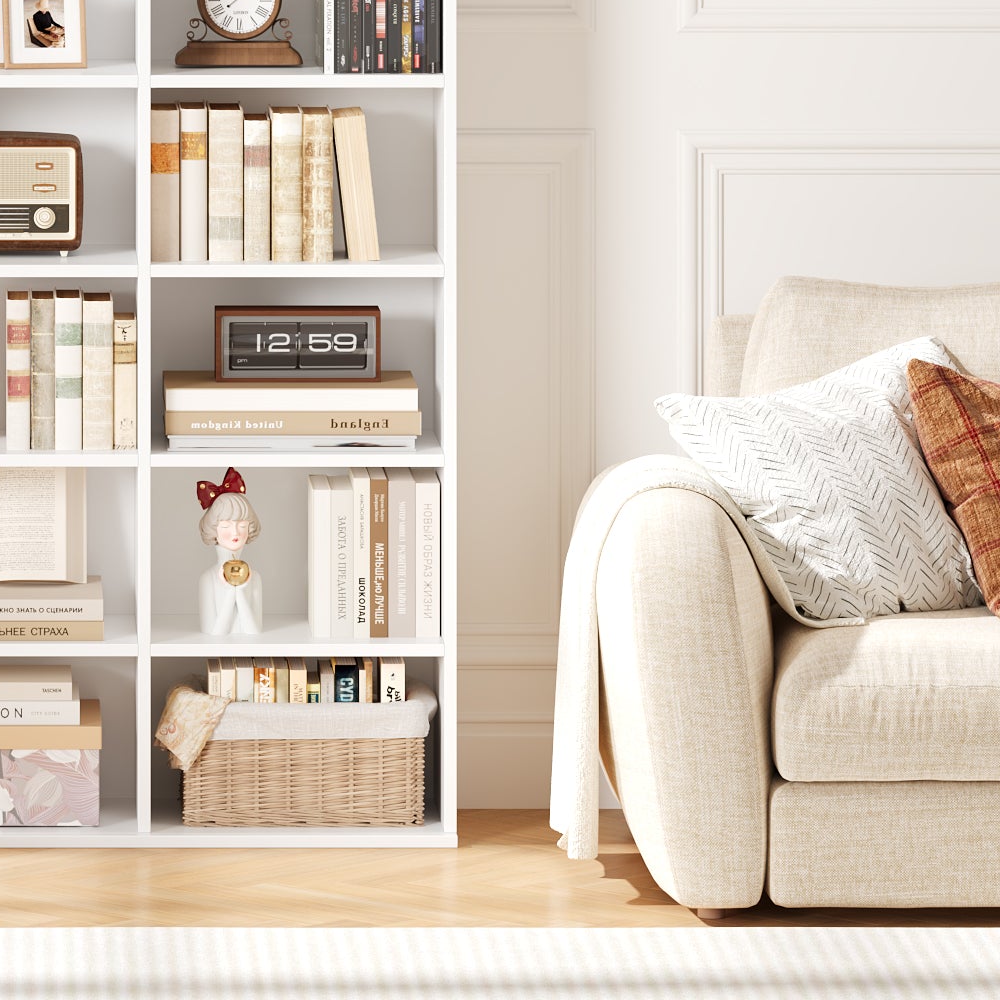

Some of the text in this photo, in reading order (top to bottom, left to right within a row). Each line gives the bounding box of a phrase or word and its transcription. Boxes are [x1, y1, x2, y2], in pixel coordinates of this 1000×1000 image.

[256, 333, 291, 353] 12
[308, 333, 358, 353] 59
[337, 515, 347, 620] ЗАБОТА О ПРЕДАННЫХ
[423, 503, 434, 619] НОВЫЙ ОБРАЗ ЖИЗНИ
[46, 607, 83, 615] СЦЕНАРИИ
[358, 577, 366, 624] ШОКОЛАД
[374, 594, 385, 625] ЛУЧШЕ
[30, 627, 69, 636] СТРАХА
[340, 677, 354, 702] CYD
